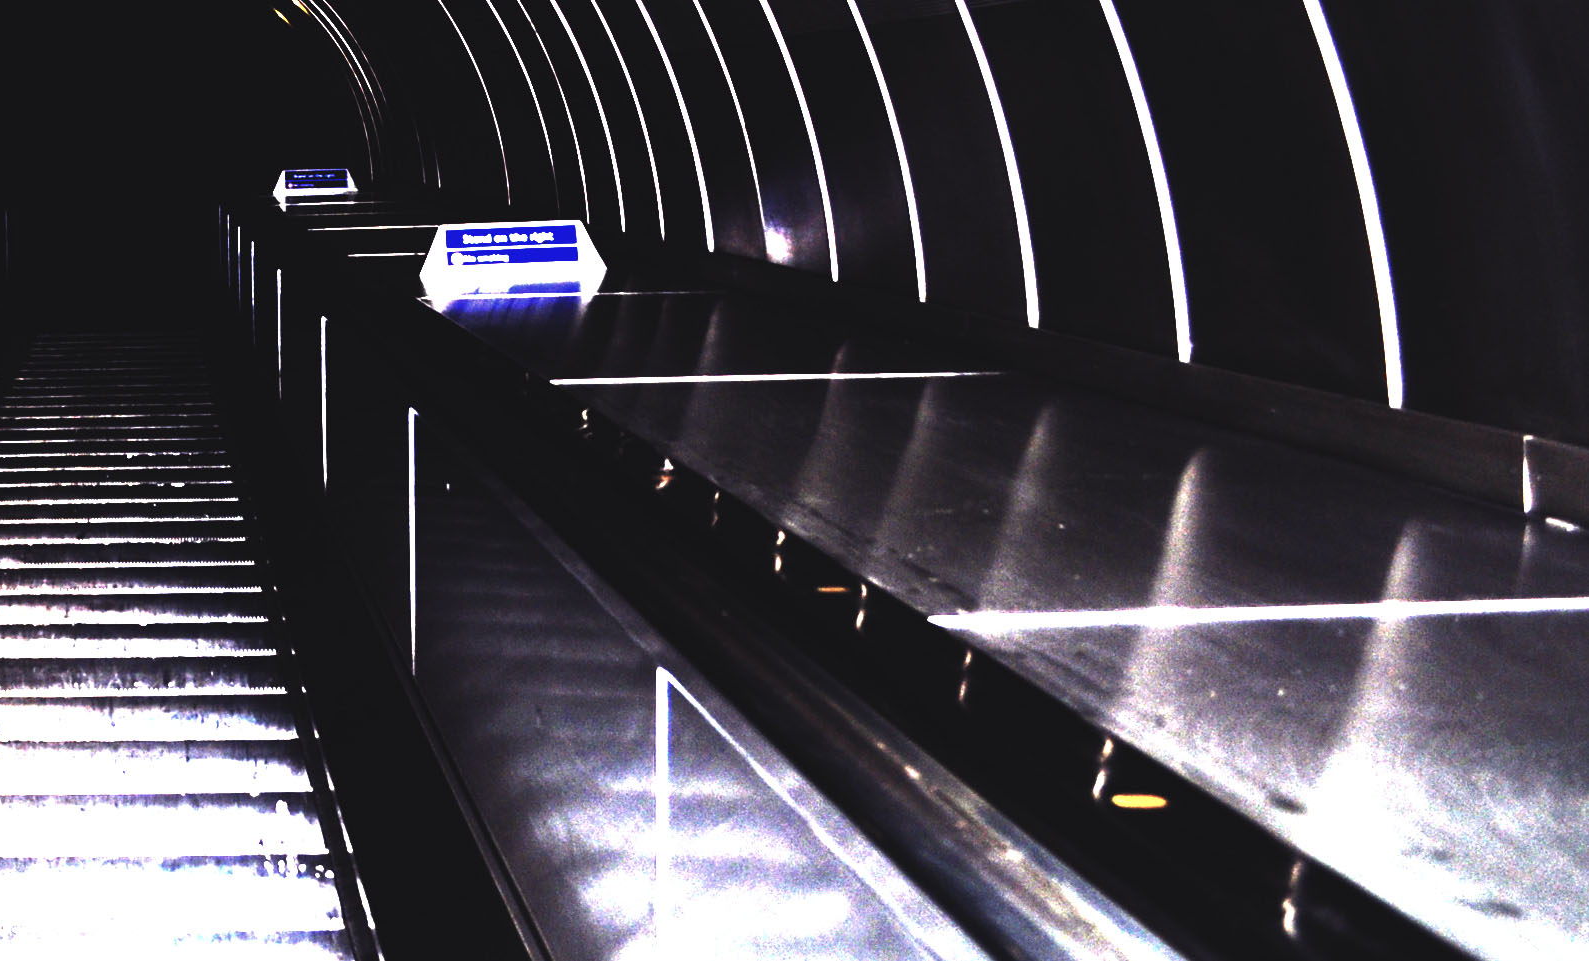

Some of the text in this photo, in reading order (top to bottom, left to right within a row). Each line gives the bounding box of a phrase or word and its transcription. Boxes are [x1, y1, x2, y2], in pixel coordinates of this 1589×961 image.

[462, 231, 555, 245] Stand on the right
